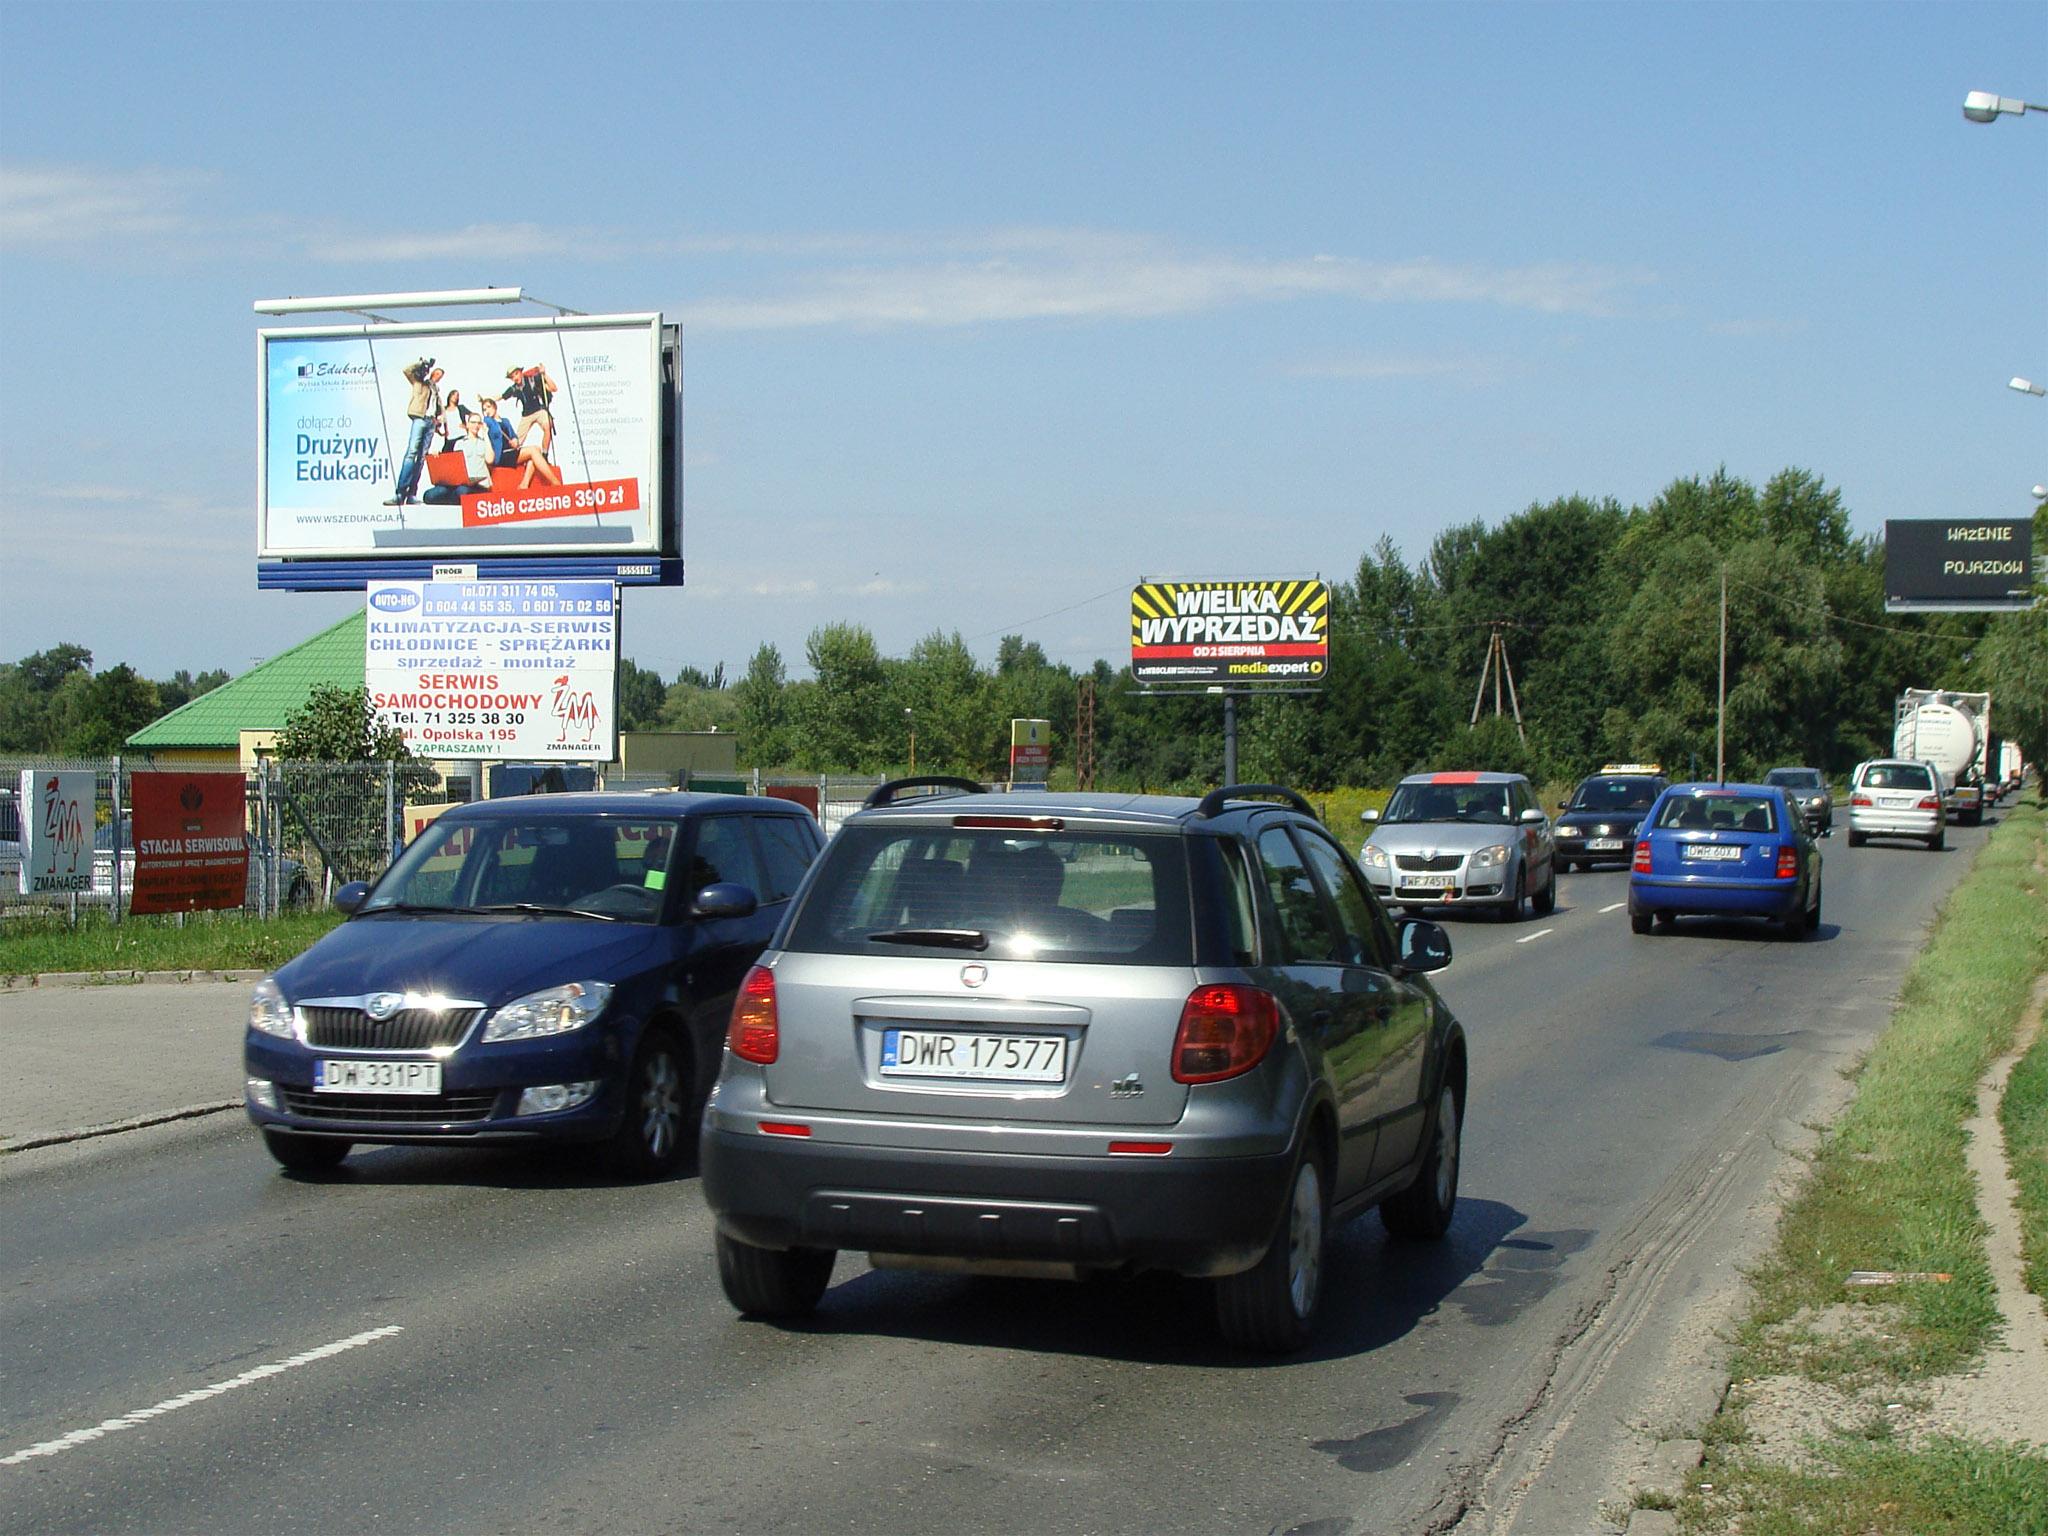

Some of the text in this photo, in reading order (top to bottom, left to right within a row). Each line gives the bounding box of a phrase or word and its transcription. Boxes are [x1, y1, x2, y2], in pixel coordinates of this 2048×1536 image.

[316, 362, 376, 377] Edukacja
[337, 414, 352, 428] do
[296, 432, 379, 459] Drużyny
[296, 458, 389, 485] Edukacji!
[476, 485, 625, 519] Stałe czesne 390 zł
[501, 584, 520, 597] 311
[524, 584, 538, 597] 74
[425, 601, 433, 612] 0
[436, 600, 458, 613] 604
[461, 600, 476, 613] 44
[479, 600, 495, 613] 55
[522, 600, 531, 612] 0
[534, 600, 555, 613] 601
[559, 600, 574, 613] 75
[577, 600, 593, 613] 02
[595, 600, 612, 613] 56
[1176, 589, 1281, 615] WIELKA
[370, 621, 612, 634] KLIMATYZACJA-SERWIS
[1141, 610, 1321, 645] WYPRZEDAŻ
[370, 638, 478, 651] CHŁODNICE
[499, 635, 611, 654] SPRĘŻARKI
[1218, 646, 1266, 656] SIERPNIA
[397, 656, 483, 669] sprzedaż
[503, 655, 577, 668] montaż
[1228, 661, 1310, 676] mediaexpert
[418, 673, 499, 690] SERWIS
[374, 693, 544, 710] SAMOCHODOWY
[392, 711, 525, 725] Tel. 71 325 38 30
[422, 727, 484, 742] Opolska
[489, 728, 517, 740] 195
[415, 743, 493, 754] ZAPRASZAMY
[546, 743, 602, 752] ZMANAGER
[140, 837, 245, 855] STACJA SERWISOWA
[34, 876, 91, 891] ZMANAGER
[901, 1035, 954, 1066] DWR
[970, 1037, 1059, 1070] 17577
